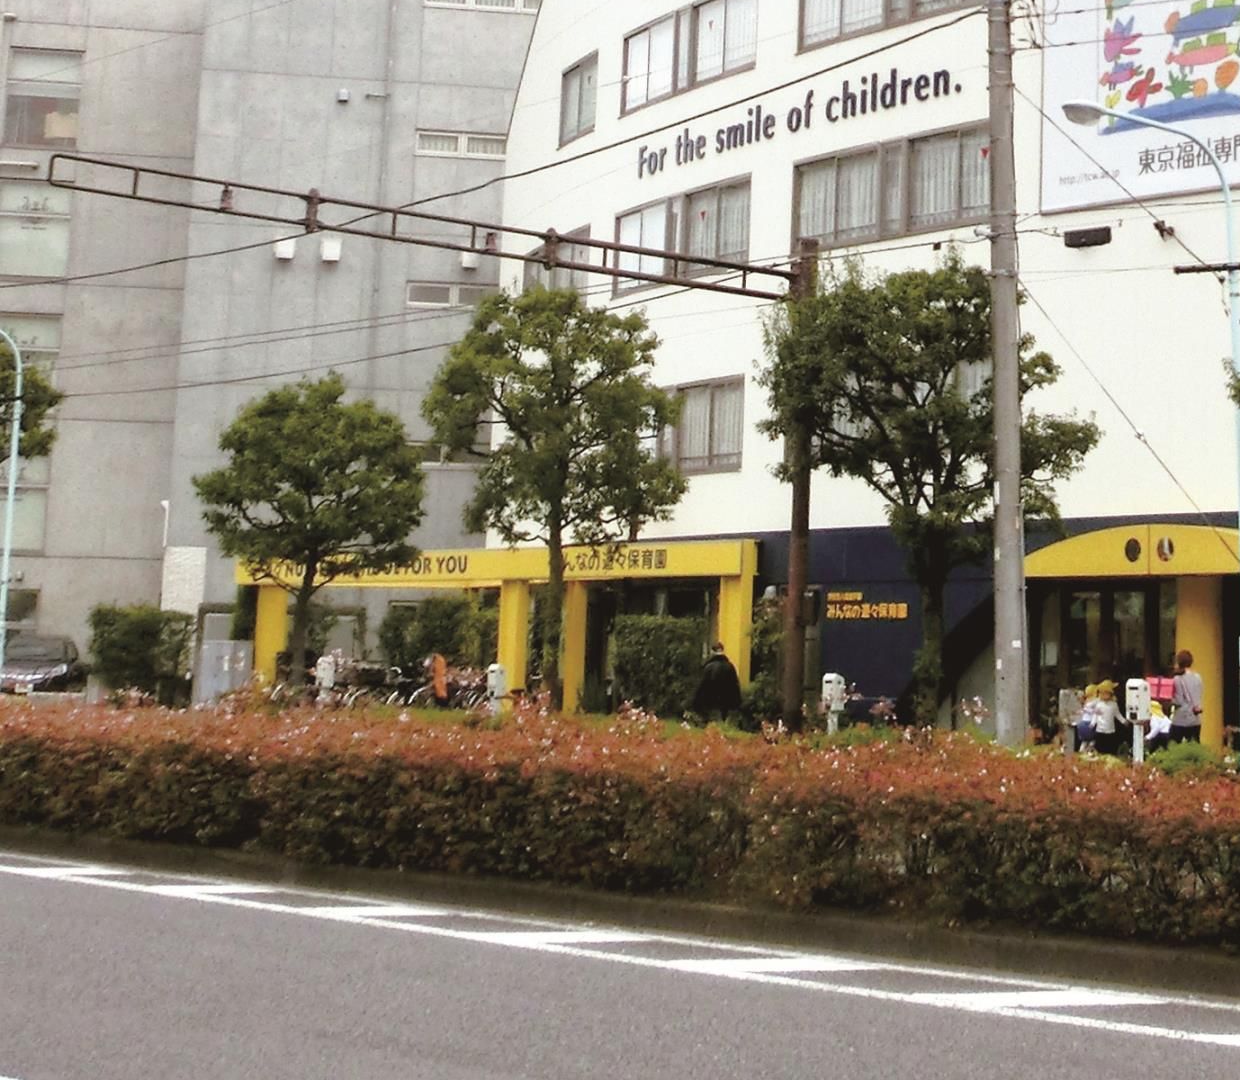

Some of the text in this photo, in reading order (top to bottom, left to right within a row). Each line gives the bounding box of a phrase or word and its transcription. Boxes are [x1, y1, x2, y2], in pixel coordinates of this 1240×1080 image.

[637, 68, 962, 179] For the smile of children.
[436, 555, 467, 574] YOU
[560, 545, 668, 572] んなの遊々保育園
